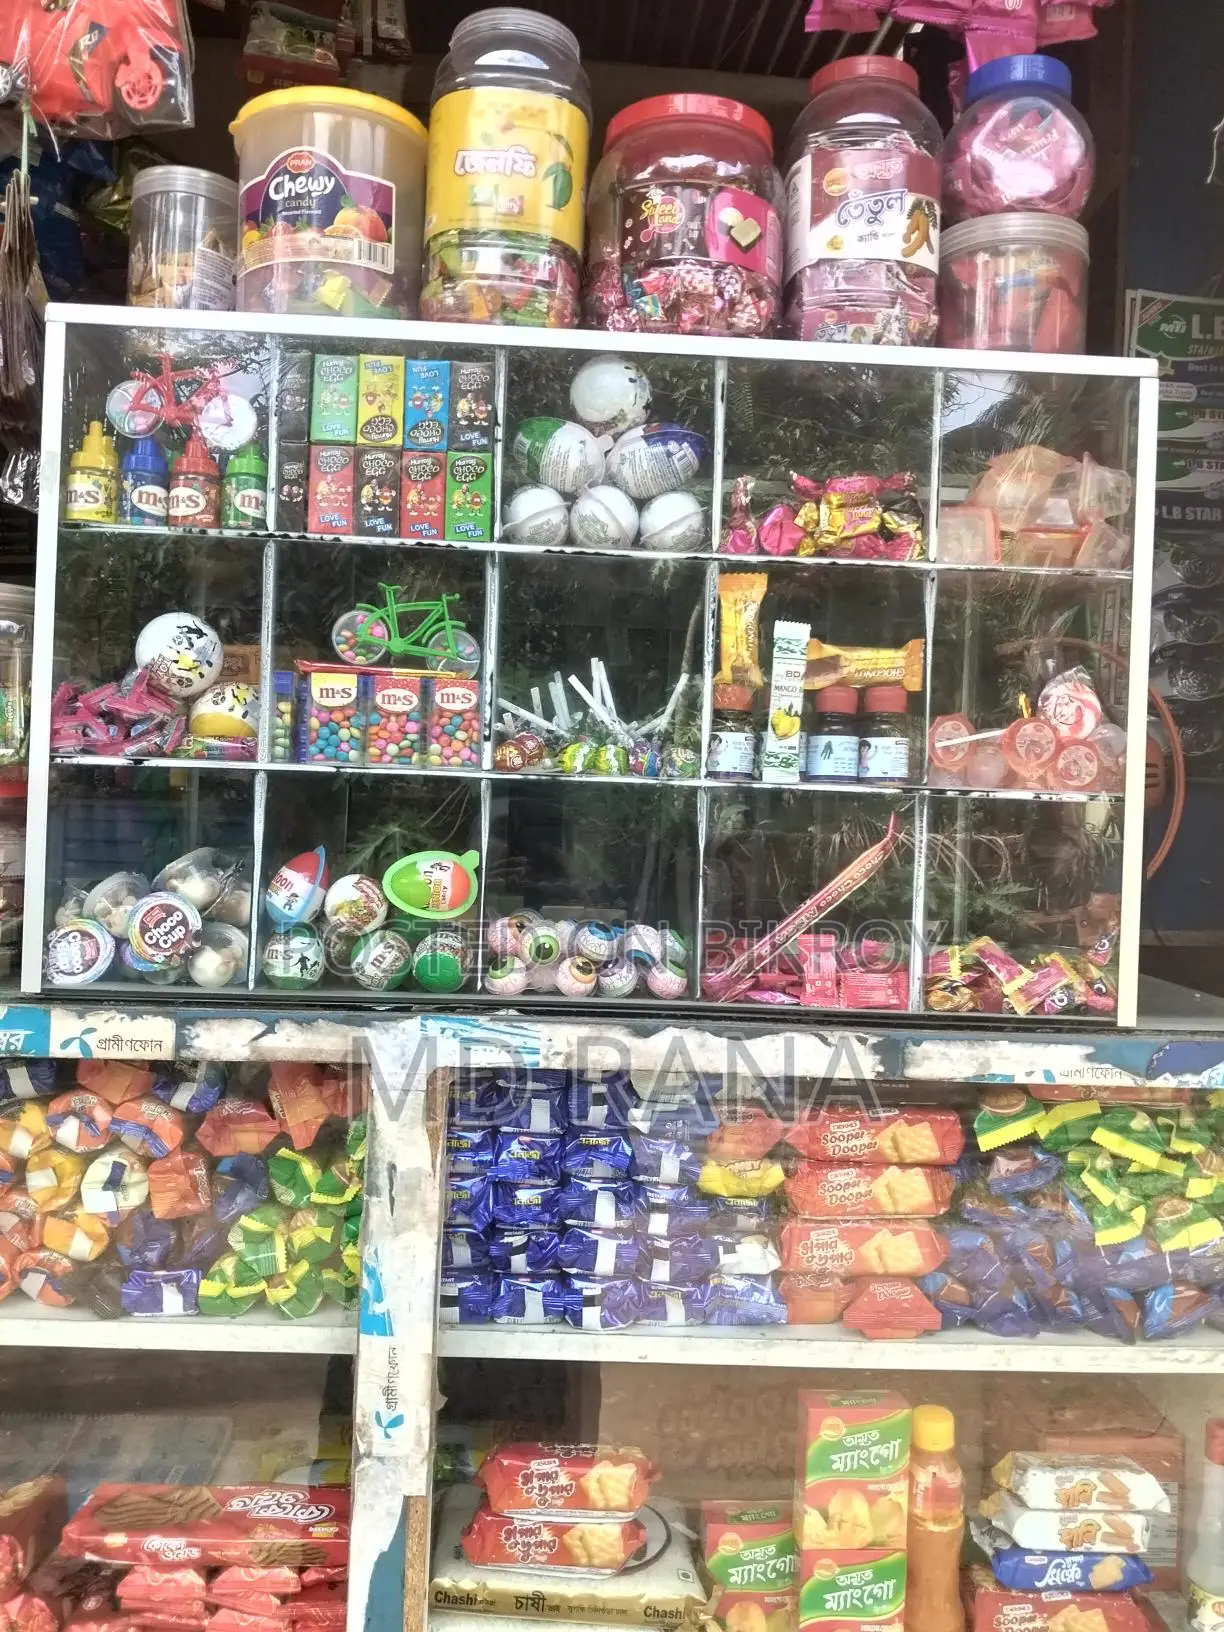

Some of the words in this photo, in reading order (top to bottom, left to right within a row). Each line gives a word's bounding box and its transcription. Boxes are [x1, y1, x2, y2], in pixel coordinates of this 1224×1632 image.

[290, 158, 312, 167] PRAN
[269, 174, 335, 200] Chewy
[285, 196, 316, 208] candy
[836, 188, 908, 227] তেঁতুল
[320, 367, 352, 375] CHOCO
[323, 374, 344, 382] EGG
[461, 382, 481, 390] EGG
[318, 456, 349, 466] CHOCO
[363, 459, 394, 469] CHOCO
[321, 463, 341, 473] EGG
[366, 467, 386, 476] EGG
[408, 465, 440, 474] CHOCO
[453, 465, 484, 475] CHOCO
[411, 472, 431, 481] EGG
[456, 473, 476, 482] EGG
[320, 514, 339, 523] LOVE
[1185, 506, 1222, 521] STAR
[332, 519, 347, 527] FUN
[365, 518, 385, 527] LOVE
[377, 523, 392, 531] FUN
[410, 523, 430, 532] LOVE
[422, 528, 438, 536] FUN
[455, 524, 475, 533] LOVE
[467, 529, 483, 537] FUN
[144, 911, 184, 946] Choco
[158, 925, 187, 949] Cup
[97, 1035, 163, 1053] গ্রামীণফোন
[821, 1129, 866, 1146] Sooper
[830, 1141, 878, 1156] Dooper
[819, 1179, 863, 1196] Sooper
[828, 1190, 873, 1206] Dooper
[830, 1438, 902, 1472] ম্যাংগো
[728, 1553, 800, 1585] ম্যাংগো
[434, 1590, 477, 1606] Chashi
[823, 1578, 896, 1611] ম্যাংগো
[514, 1590, 547, 1613] চাষী
[644, 1605, 686, 1620] Chashi
